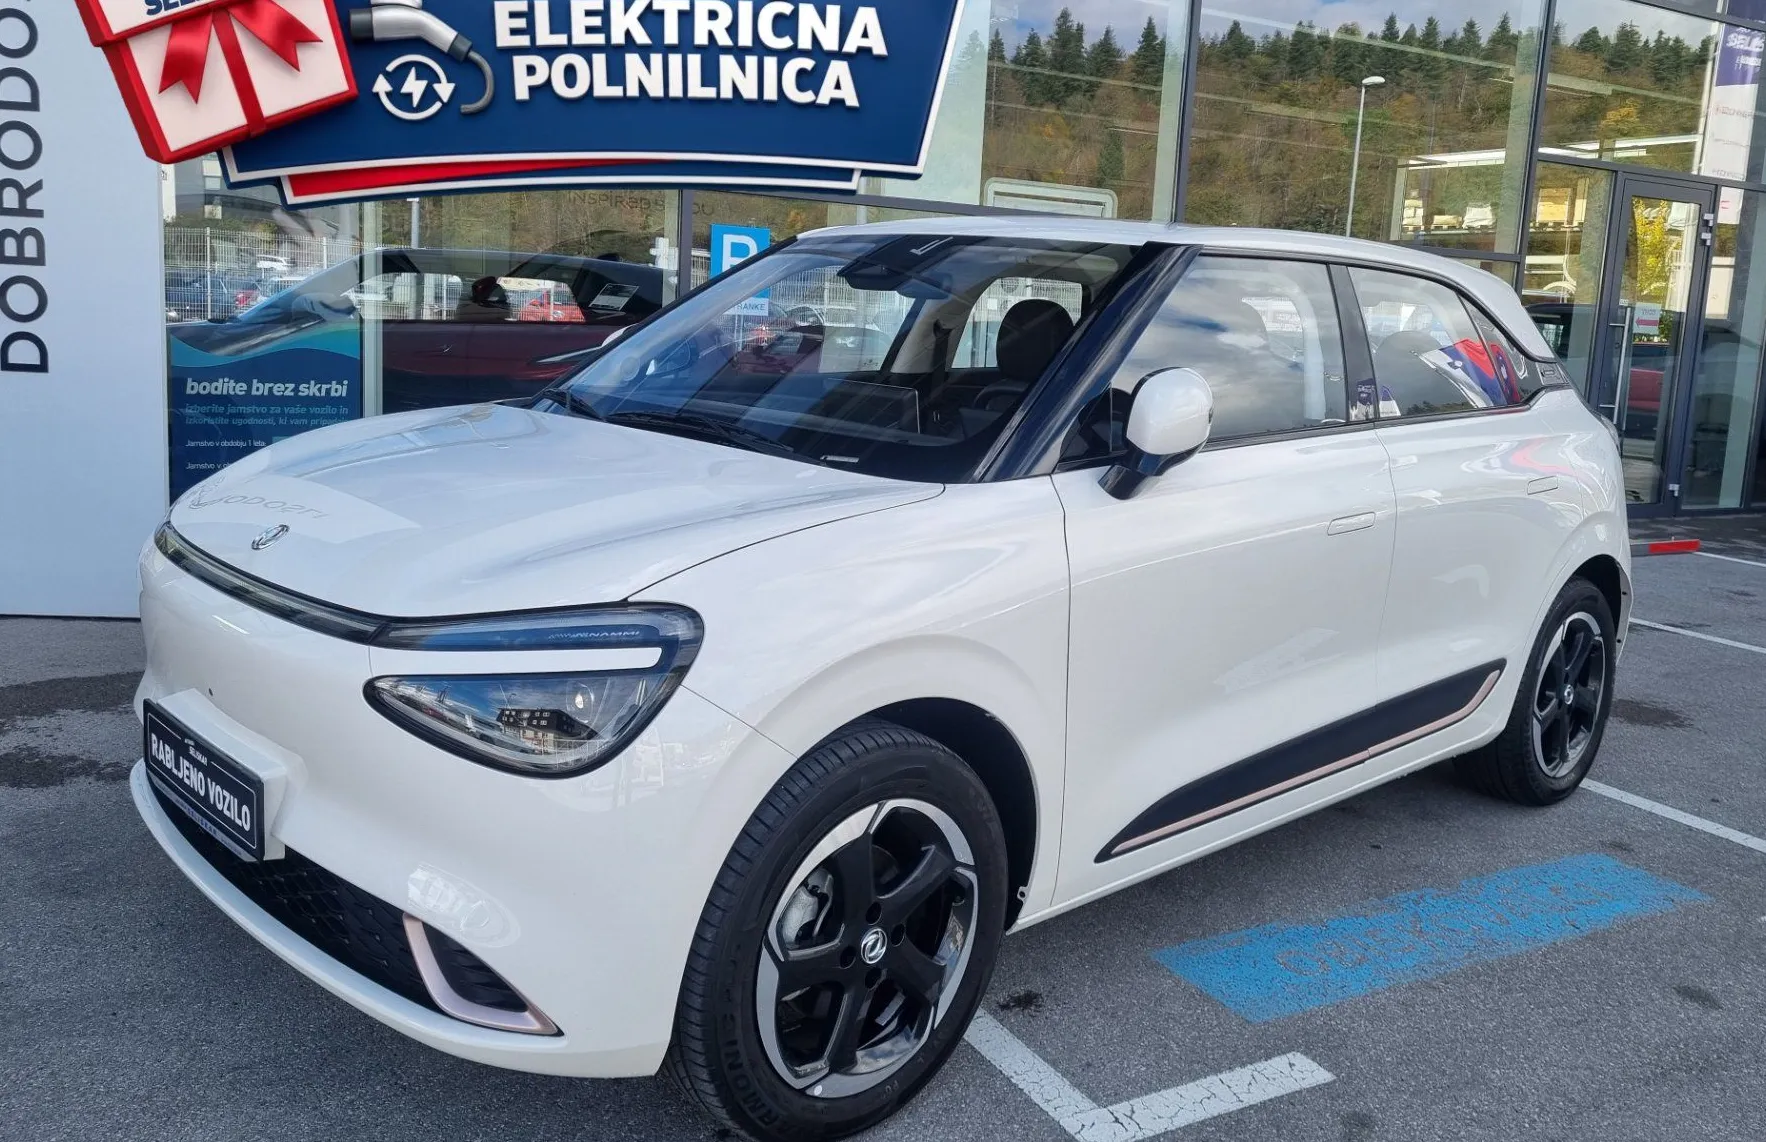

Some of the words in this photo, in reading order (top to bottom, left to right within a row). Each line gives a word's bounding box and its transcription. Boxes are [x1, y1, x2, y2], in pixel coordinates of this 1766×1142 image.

[722, 233, 758, 272] P
[185, 378, 248, 395] bodite
[251, 379, 295, 396] brez
[298, 380, 349, 397] skrbi
[226, 404, 267, 416] jamstvo
[269, 406, 281, 414] za
[284, 404, 307, 414] vaše
[309, 405, 337, 415] vozilo
[339, 406, 349, 415] in
[279, 417, 288, 425] ki
[290, 418, 308, 426] vam
[185, 462, 215, 470] Jamstvo
[151, 732, 205, 798] RABLJENO
[208, 777, 251, 832] VOZILO
